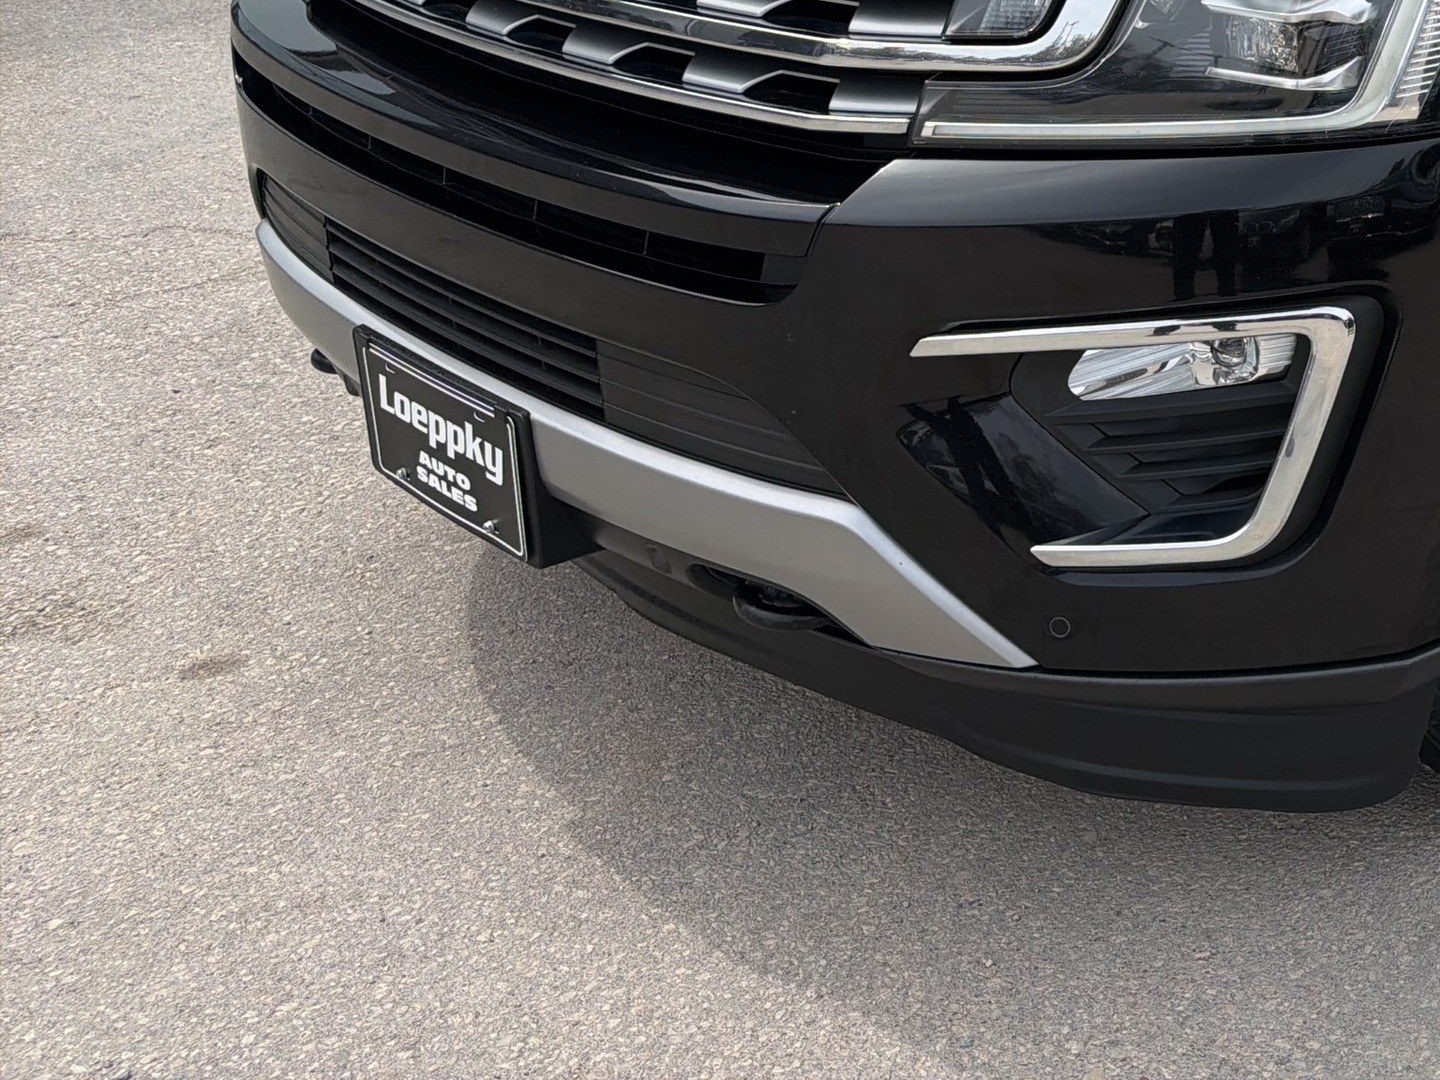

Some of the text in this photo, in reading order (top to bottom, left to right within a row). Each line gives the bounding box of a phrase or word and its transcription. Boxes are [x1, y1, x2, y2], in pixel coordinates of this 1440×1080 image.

[378, 372, 504, 487] Loeppky
[416, 465, 479, 513] SALES
[418, 449, 472, 492] AUTO
